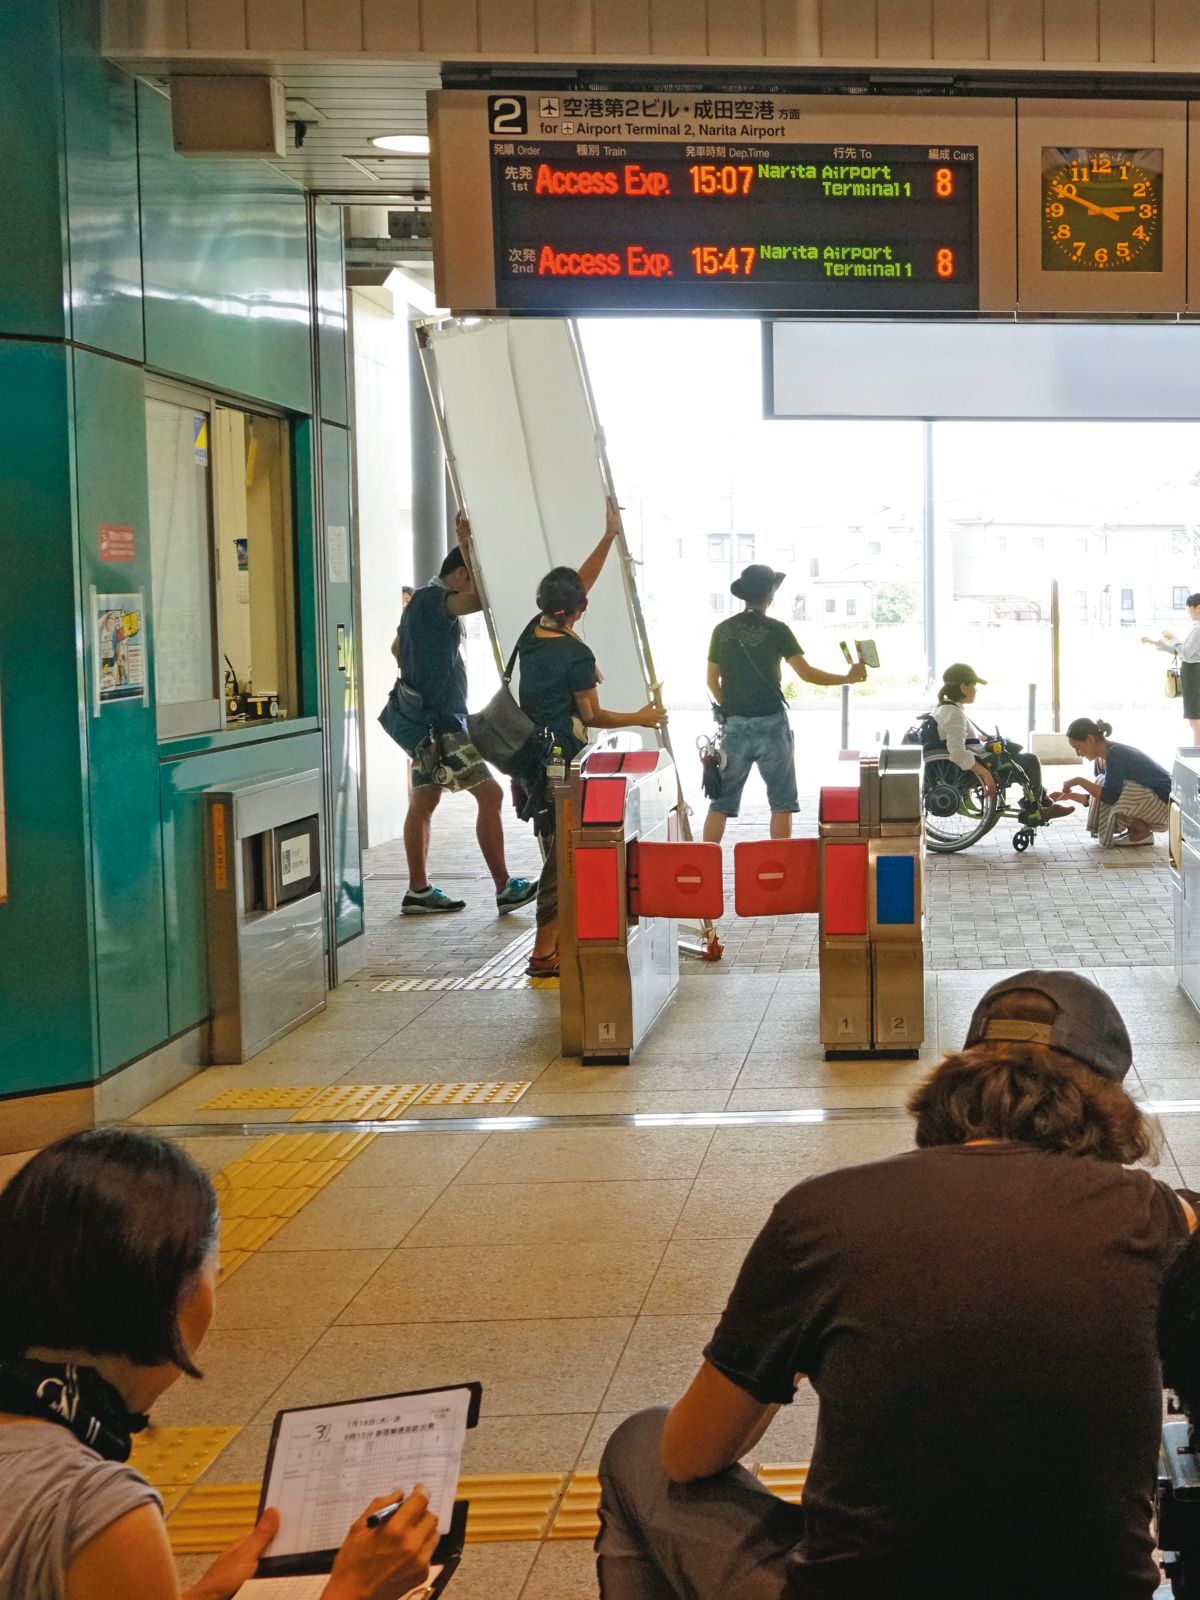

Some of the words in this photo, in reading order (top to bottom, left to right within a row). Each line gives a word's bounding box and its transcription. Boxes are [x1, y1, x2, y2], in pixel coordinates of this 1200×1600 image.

[493, 98, 522, 133] 2
[563, 98, 775, 120] 空港第2ビル・成田空港
[778, 108, 800, 120] 方面
[540, 123, 558, 134] for
[576, 123, 624, 137] Airport
[626, 123, 680, 136] Terminal
[684, 124, 695, 137] 2,
[699, 124, 737, 136] Narita
[740, 125, 786, 138] Airport
[517, 146, 541, 156] Order
[576, 144, 600, 156] 種別
[603, 146, 626, 157] Train
[686, 146, 726, 158] 発車時刻
[833, 147, 857, 159] 行先
[859, 149, 872, 159] To
[953, 150, 975, 161] Cars
[504, 166, 533, 180] 先発
[1091, 159, 1112, 173] 12
[1120, 166, 1128, 180] 1
[535, 163, 619, 195] Access
[624, 164, 671, 196] Exp.
[689, 165, 754, 195] 15:07
[758, 164, 817, 179] Narita
[822, 164, 891, 180] Airport
[936, 168, 953, 197] 8
[1071, 167, 1089, 182] 11
[511, 181, 529, 192] 1st
[822, 181, 900, 197] Terminal
[903, 182, 911, 197] 1
[1132, 182, 1146, 197] 2
[1050, 202, 1064, 218] 9
[1139, 203, 1152, 219] 3
[1056, 224, 1071, 239] 8
[1131, 225, 1145, 239] 4
[508, 248, 536, 263] 次発
[1073, 242, 1086, 256] 7
[1094, 248, 1108, 262] 6
[1116, 242, 1130, 257] 5
[538, 245, 621, 276] Access
[627, 246, 673, 277] Exp.
[692, 247, 756, 276] 15:47
[760, 244, 819, 260] Narita
[823, 245, 892, 261] Airport
[936, 248, 954, 278] 8
[512, 264, 534, 273] 2nd
[824, 262, 900, 277] Terminal
[904, 262, 912, 277] 1
[842, 1017, 849, 1030] 1
[894, 1017, 905, 1029] 2
